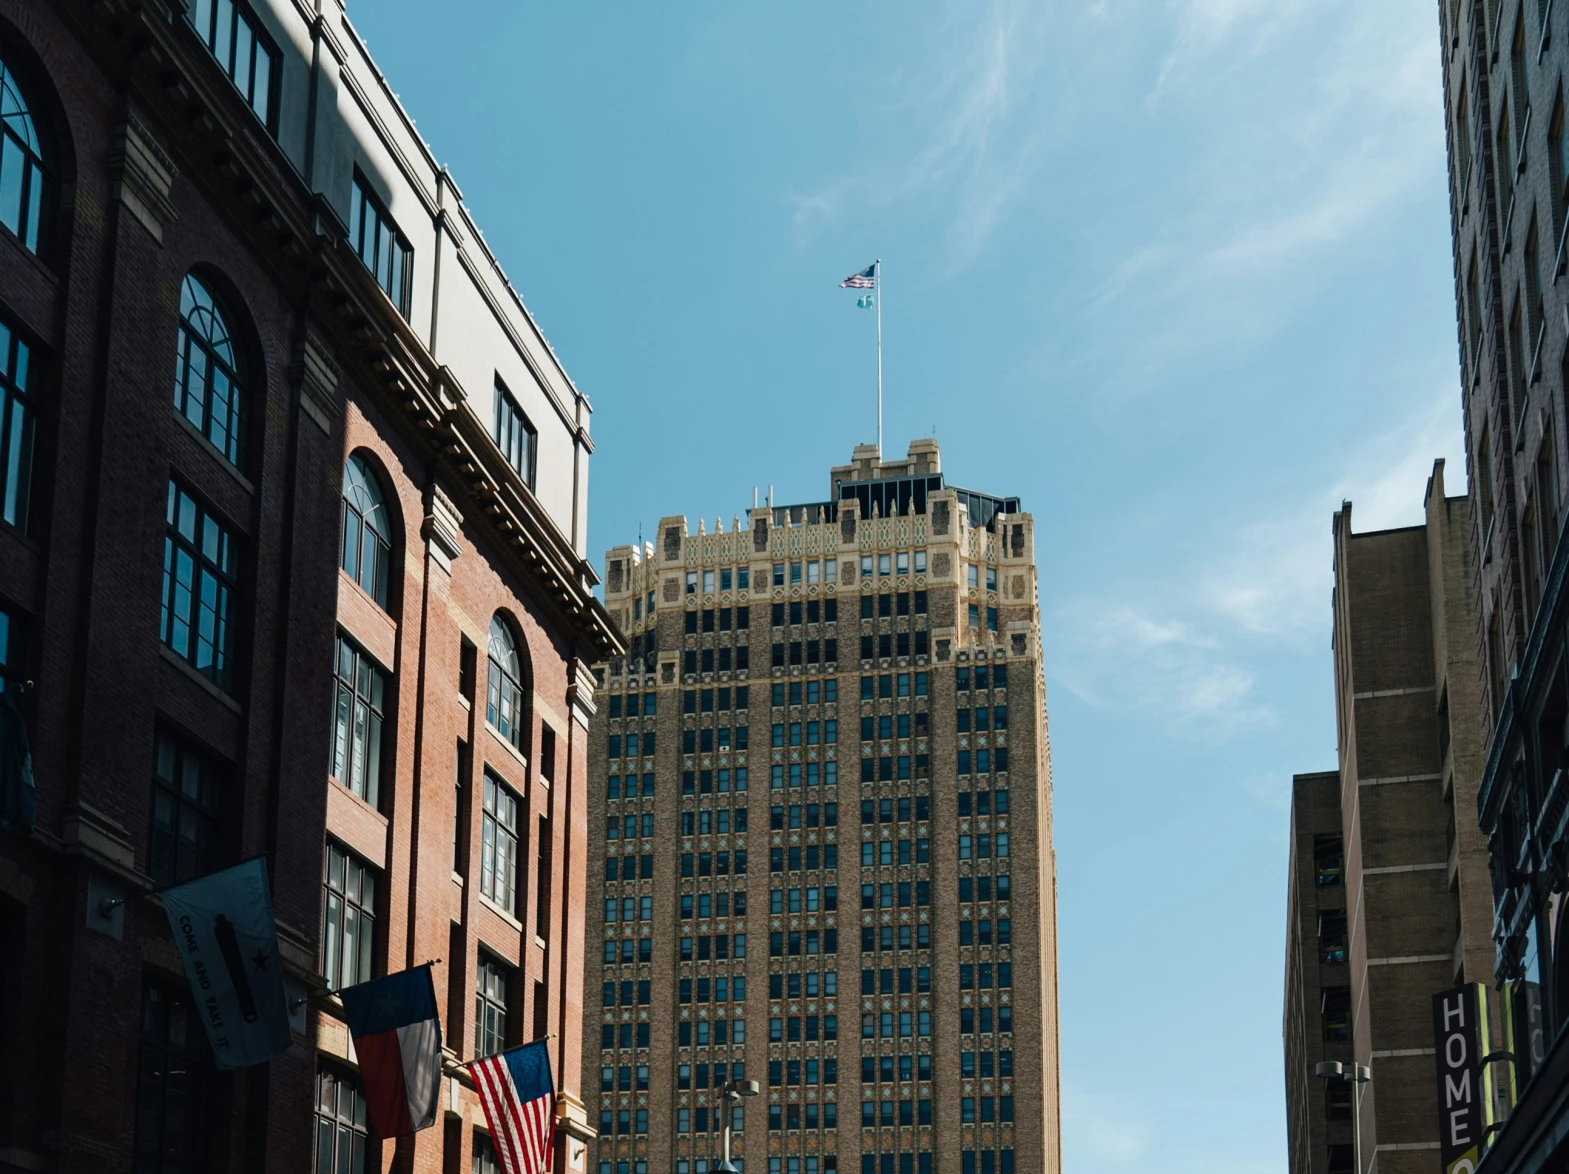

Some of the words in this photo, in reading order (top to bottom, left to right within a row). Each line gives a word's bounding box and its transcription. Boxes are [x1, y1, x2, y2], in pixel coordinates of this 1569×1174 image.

[179, 915, 200, 954] COME
[193, 960, 212, 990] AND
[205, 996, 224, 1029] TAKE
[216, 1036, 230, 1048] IT
[1442, 993, 1472, 1146] HOME
